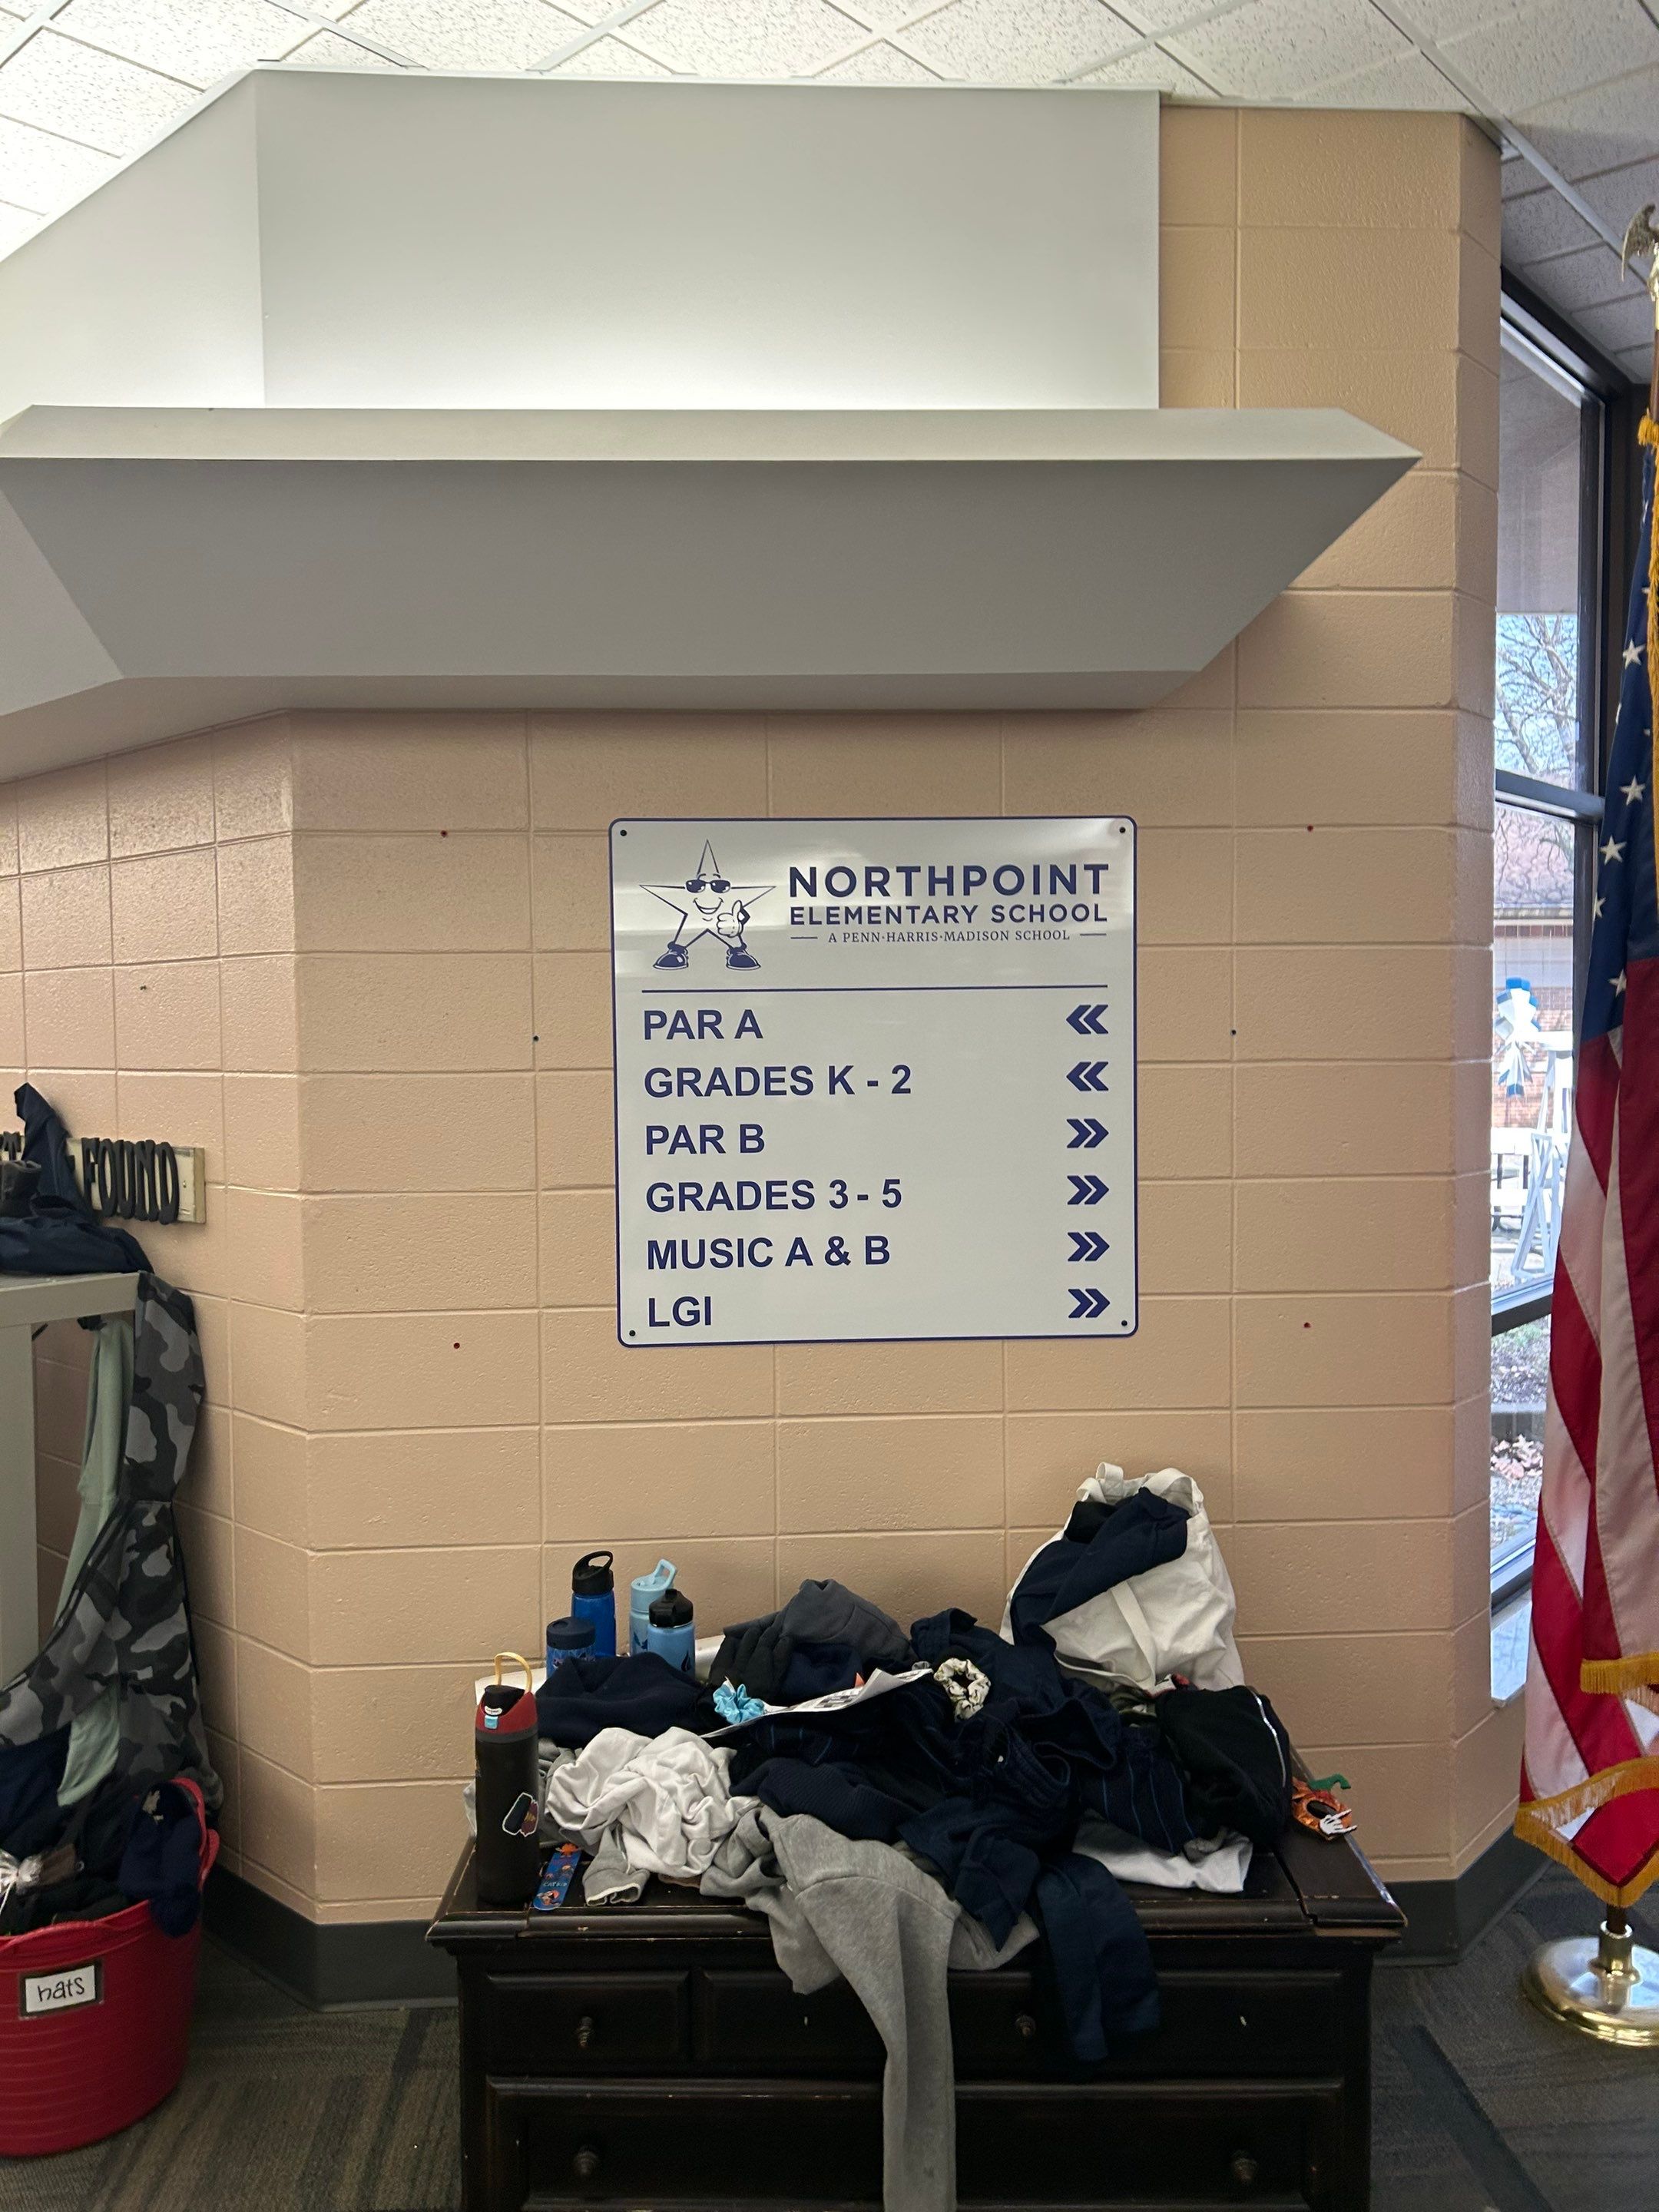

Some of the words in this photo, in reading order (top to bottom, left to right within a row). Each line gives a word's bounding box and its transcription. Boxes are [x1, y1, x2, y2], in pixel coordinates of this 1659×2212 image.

[790, 863, 1109, 898] NORTHPOINT
[790, 905, 979, 926] ELEMENTARY
[991, 903, 1108, 923] SCHOOL
[828, 932, 837, 943] A
[1015, 930, 1071, 942] SCHOOL
[644, 1009, 725, 1041] PAR
[733, 1009, 763, 1039] A
[644, 1065, 814, 1098] GRADES
[828, 1065, 856, 1095] K
[891, 1065, 912, 1094] 2
[646, 1124, 727, 1155] PAR
[740, 1124, 765, 1154] B
[81, 1137, 180, 1225] FOUND
[646, 1179, 816, 1213] GRADES
[829, 1179, 849, 1210] 3
[882, 1178, 902, 1208] 5
[647, 1237, 773, 1270] MUSIC
[784, 1237, 813, 1267] A
[824, 1236, 852, 1267] &
[865, 1235, 890, 1265] B
[648, 1296, 711, 1327] LGI
[38, 1977, 85, 2002] hats
